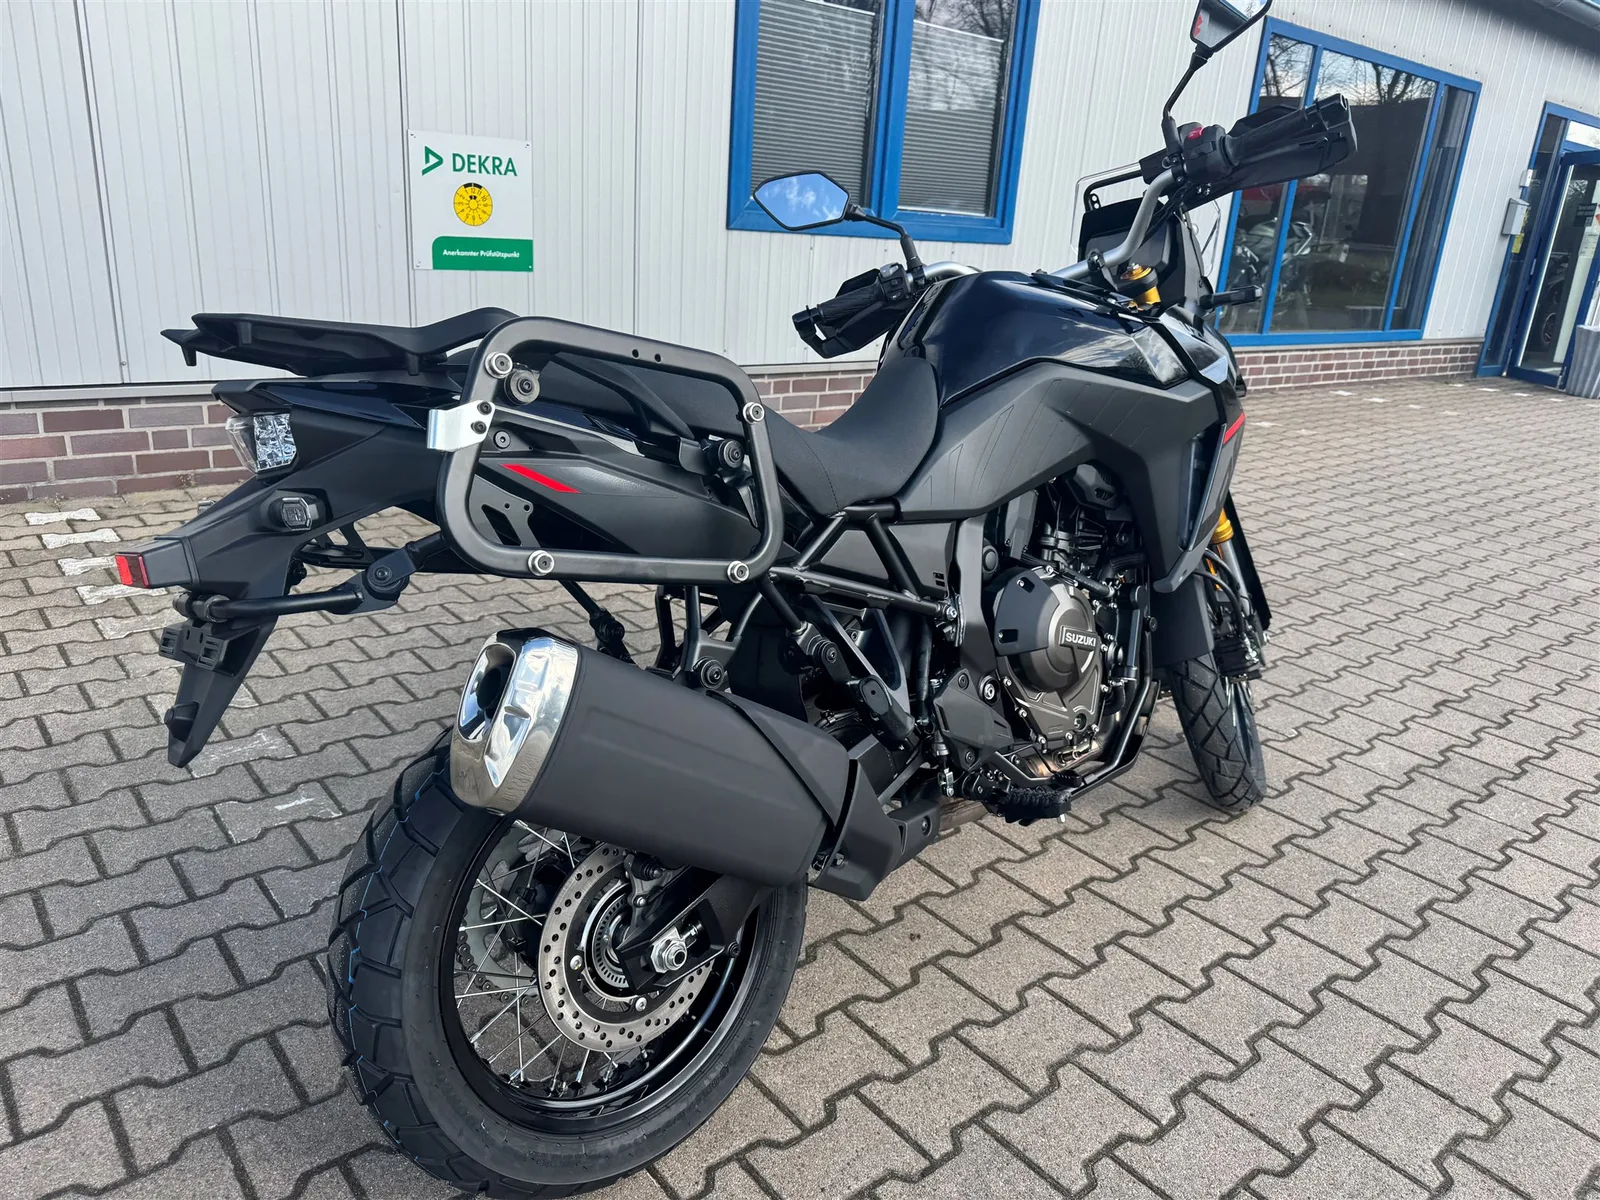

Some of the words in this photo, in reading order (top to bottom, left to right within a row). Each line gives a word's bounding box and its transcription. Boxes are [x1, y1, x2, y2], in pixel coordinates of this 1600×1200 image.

[452, 152, 517, 177] DEKRA
[442, 249, 480, 257] Anerkannter
[480, 250, 520, 259] Prüfstützpunkt
[1065, 632, 1097, 647] SUZUKI
